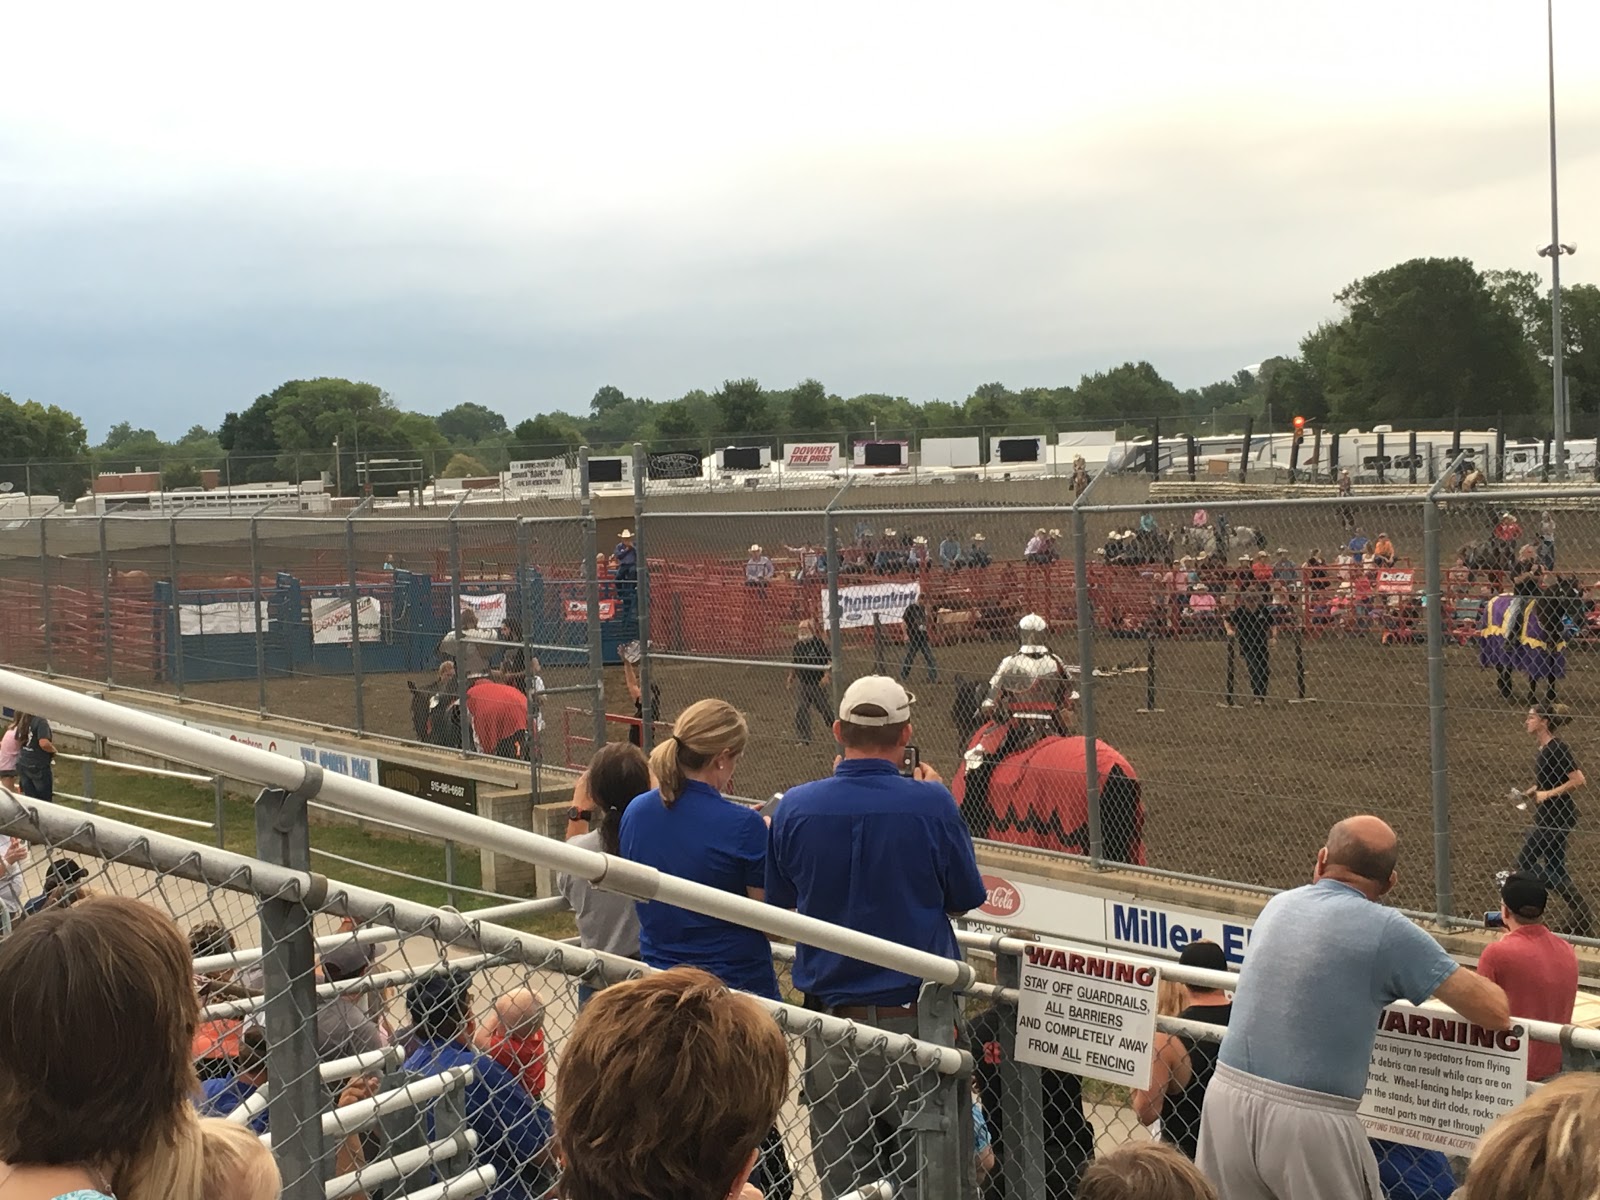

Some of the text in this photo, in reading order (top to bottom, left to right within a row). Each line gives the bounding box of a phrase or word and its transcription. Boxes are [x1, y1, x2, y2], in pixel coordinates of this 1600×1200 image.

[789, 455, 832, 466] TIRE PROS
[792, 446, 836, 455] DOWNEY
[1113, 904, 1203, 952] Miller
[1027, 946, 1155, 987] WARNING
[1024, 975, 1150, 1013] STAY OFF GUARDRAILS,
[1045, 1001, 1123, 1027] ALL BARRIERS
[1378, 1009, 1521, 1052] ARNING
[1019, 1016, 1148, 1054] AND COMPLETELY AWAY
[1028, 1038, 1135, 1072] FROM ALL FENCING
[1389, 1043, 1412, 1058] injury
[1413, 1048, 1422, 1058] to
[1423, 1050, 1463, 1065] spectators
[1465, 1056, 1485, 1069] from
[1487, 1059, 1511, 1075] flying
[1378, 1056, 1402, 1070] debris
[1403, 1063, 1417, 1073] can
[1418, 1065, 1441, 1077] result
[1443, 1069, 1465, 1081] while
[1466, 1075, 1483, 1085] cars
[1485, 1079, 1499, 1088] are
[1501, 1082, 1512, 1090] on
[1374, 1087, 1387, 1098] the
[1388, 1091, 1414, 1105] stands,
[1417, 1095, 1430, 1107] but
[1432, 1098, 1447, 1110] dirt
[1448, 1101, 1470, 1116] clods,
[1473, 1108, 1494, 1120] rocks
[1393, 1074, 1449, 1097] Wheel-fencing
[1451, 1086, 1473, 1100] helps
[1475, 1090, 1495, 1104] keep
[1497, 1096, 1514, 1107] cars
[1361, 1119, 1388, 1133] CEPTING
[1389, 1124, 1406, 1136] YOUR
[1422, 1132, 1435, 1143] YOU
[1435, 1135, 1447, 1146] ARE
[1447, 1137, 1477, 1150] ACCEPTI
[1374, 1104, 1485, 1135] metal parts may get through
